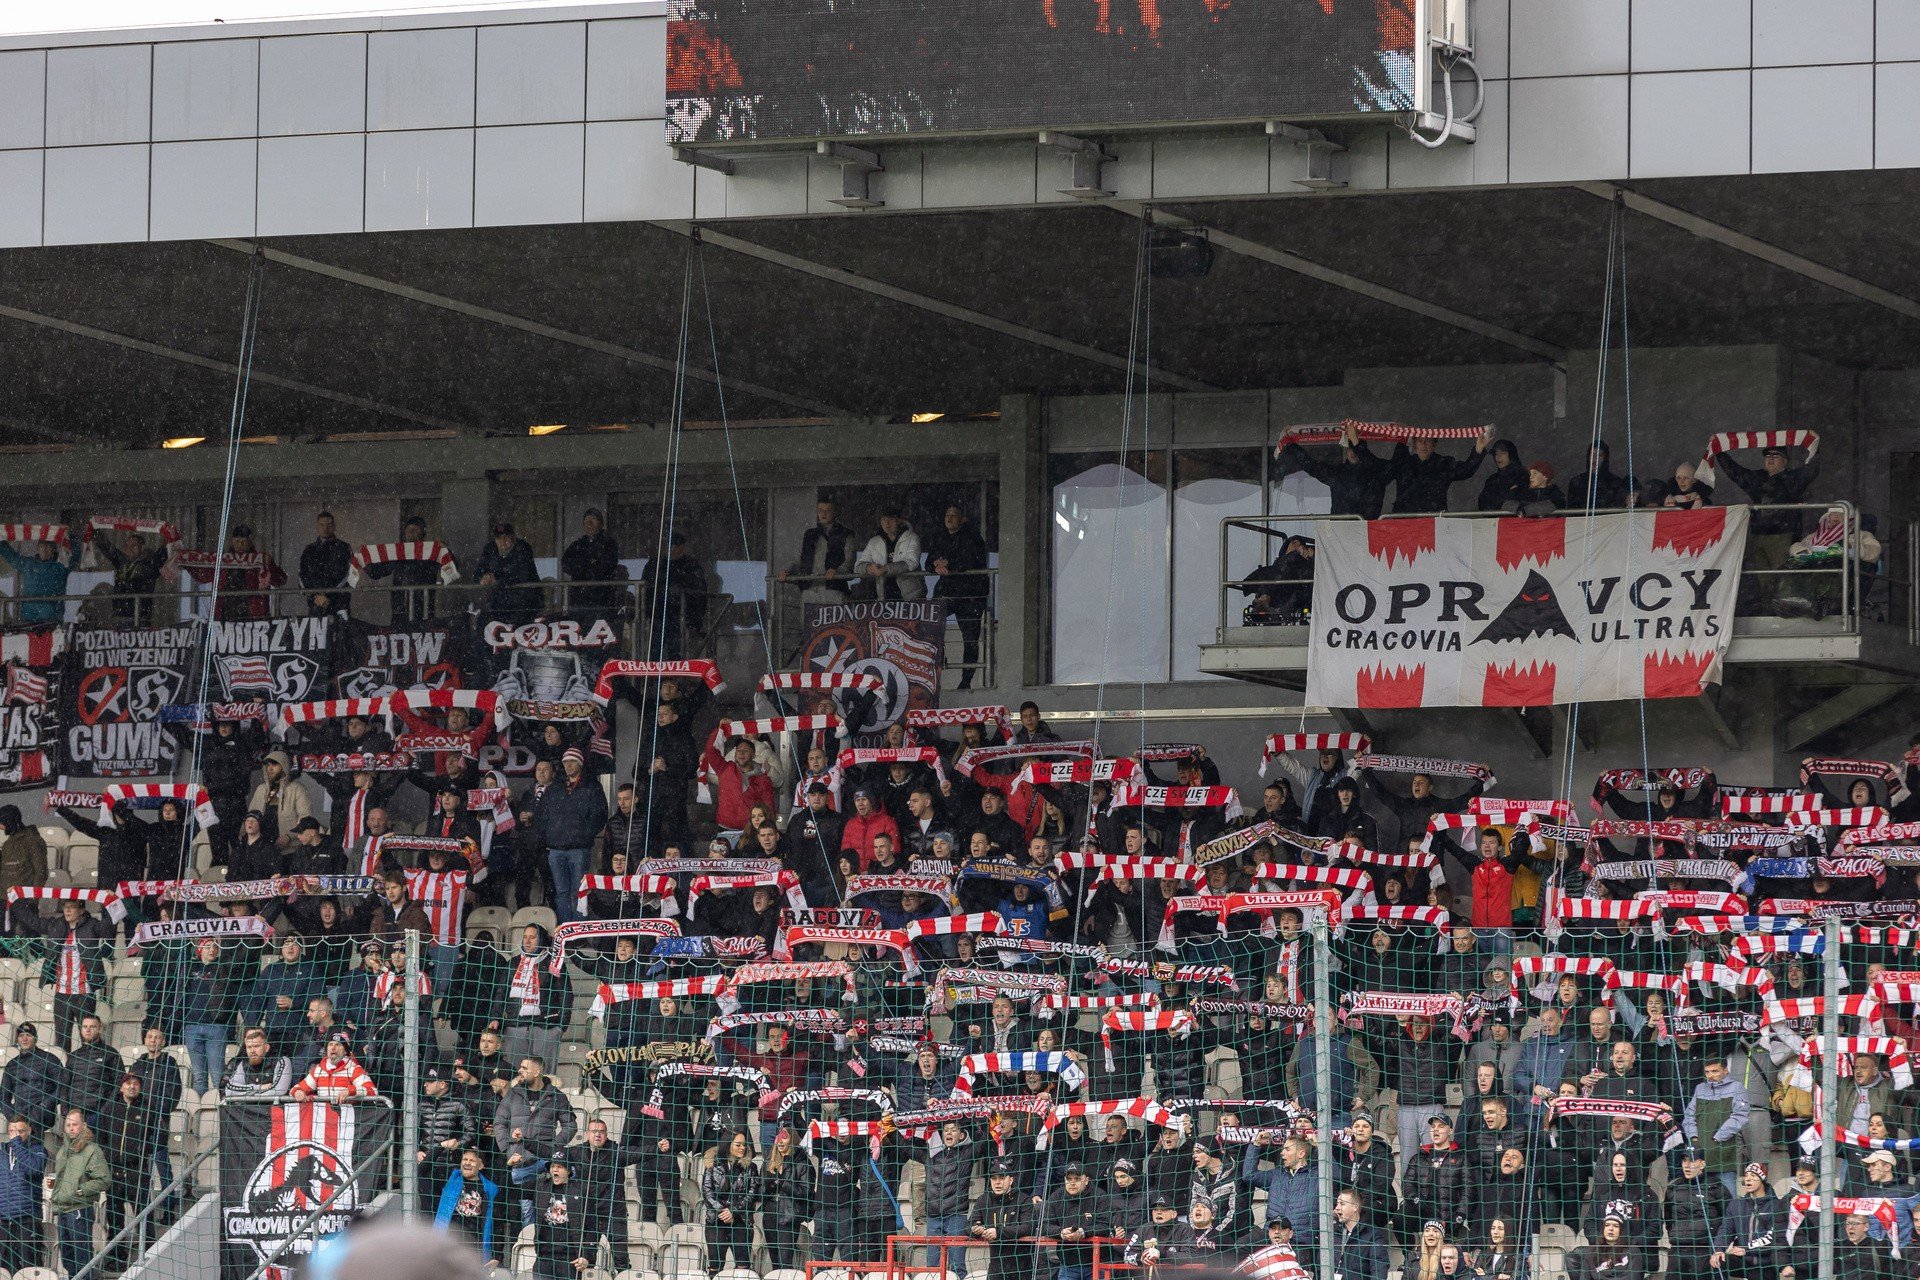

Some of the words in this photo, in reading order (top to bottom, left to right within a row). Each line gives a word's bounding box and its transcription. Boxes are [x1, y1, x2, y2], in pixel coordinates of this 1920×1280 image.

[811, 602, 867, 628] JEDNO
[870, 601, 941, 624] OSIEDLE
[212, 616, 329, 654] MURZYN
[483, 616, 617, 652] GÓRA
[1590, 613, 1721, 643] ULTRAS
[1326, 627, 1462, 652] CRACOVIA
[367, 632, 446, 667] PDW
[84, 651, 104, 668] DO
[618, 660, 690, 673] CRACOVIA
[858, 747, 915, 758] CRACOVIA
[1380, 758, 1468, 773] PROSZOWICE
[1483, 800, 1547, 811] CRACOVIA
[911, 860, 954, 875] CRACOVIA
[849, 876, 947, 892] CRACOVIA
[1244, 893, 1323, 905] CRACOVIA
[1873, 901, 1917, 914] Cracovia
[150, 919, 241, 937] CRACOVIA
[596, 919, 641, 931] JESTEM
[1007, 918, 1031, 936] STS
[803, 927, 892, 942] CRACOVIA
[991, 938, 1023, 950] DERBY
[1175, 964, 1234, 985] HUTA
[1881, 971, 1898, 983] KS
[720, 1011, 822, 1027] CRACOVIA
[1697, 1015, 1742, 1031] Wybacza
[895, 1108, 991, 1127] CRACOVIA
